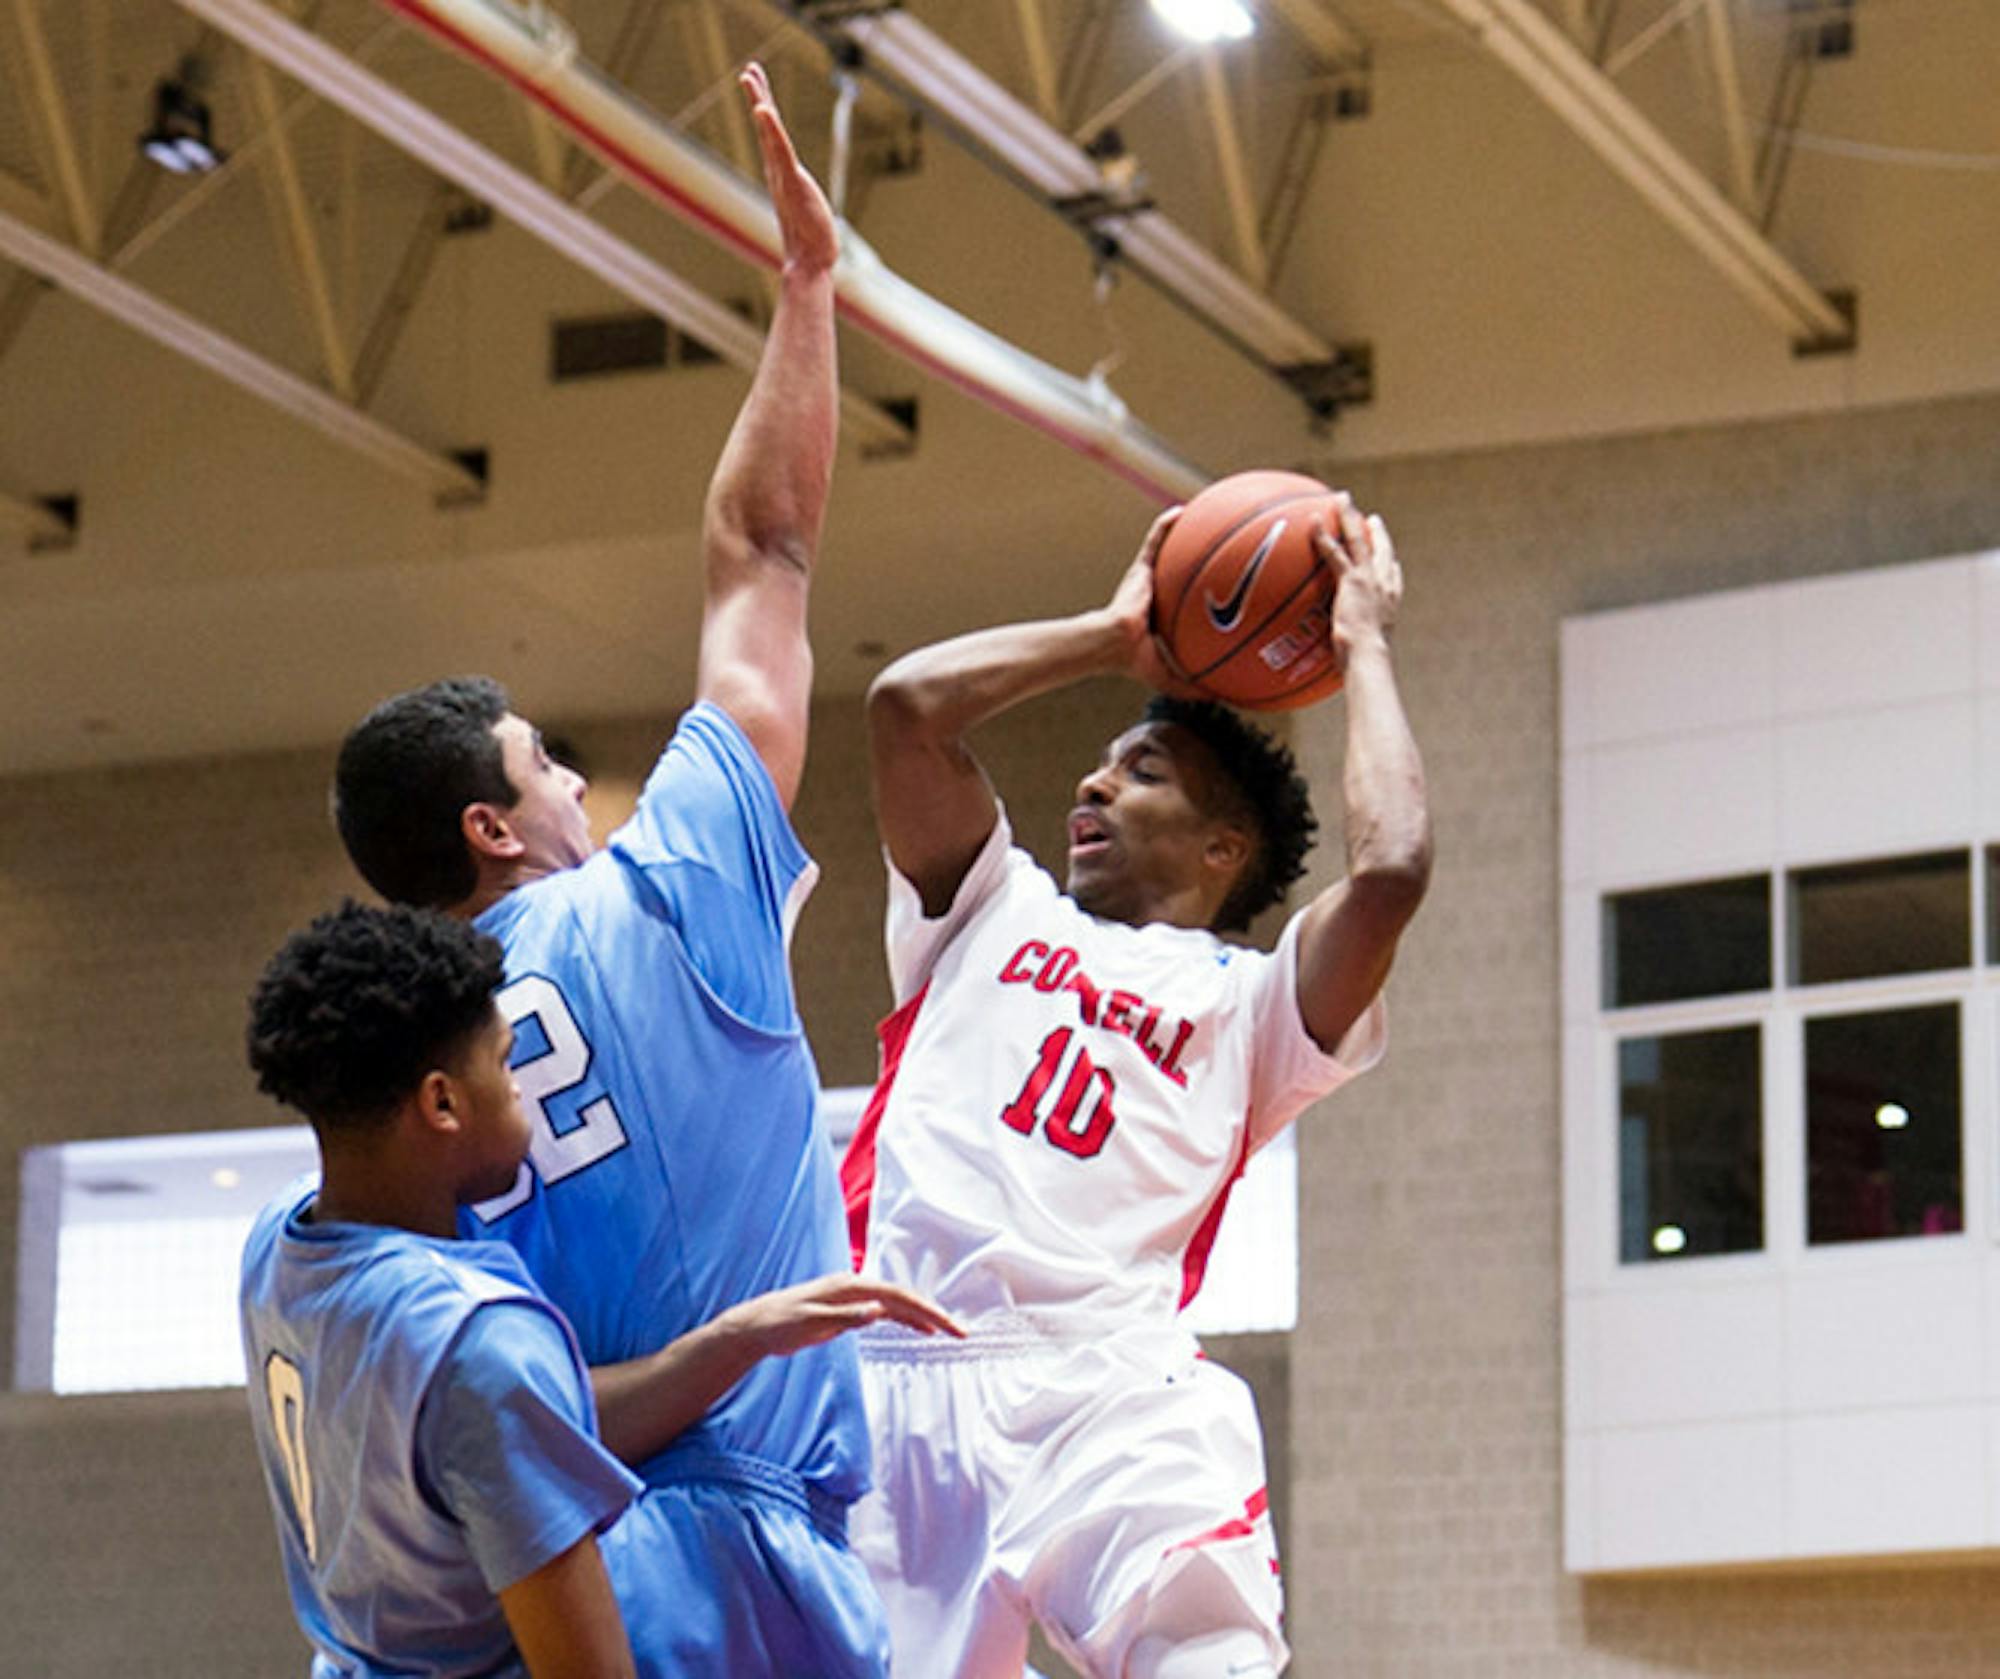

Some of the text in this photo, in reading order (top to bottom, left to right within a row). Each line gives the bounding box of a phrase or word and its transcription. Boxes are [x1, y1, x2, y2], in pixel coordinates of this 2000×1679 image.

[470, 971, 631, 1228] 2
[999, 1025, 1116, 1160] 10
[264, 1347, 317, 1570] 0
